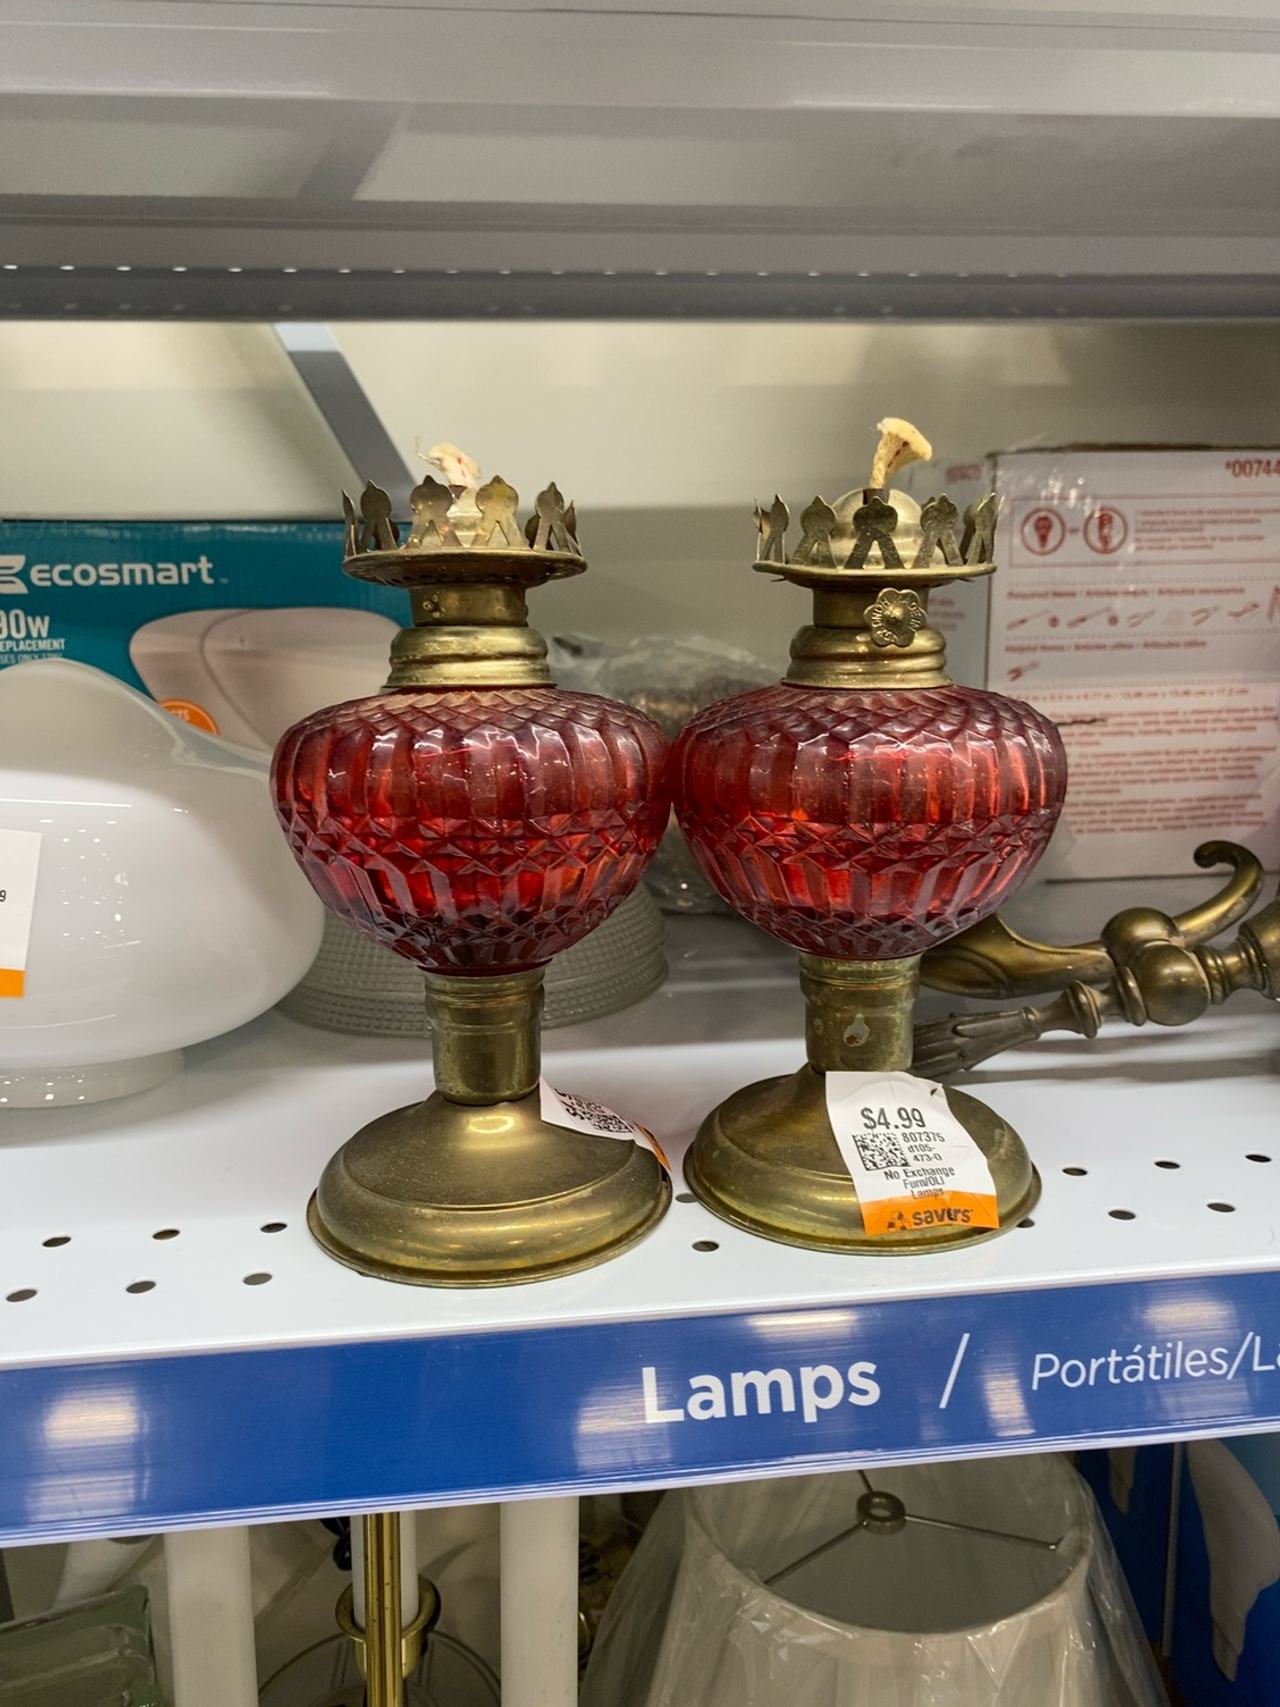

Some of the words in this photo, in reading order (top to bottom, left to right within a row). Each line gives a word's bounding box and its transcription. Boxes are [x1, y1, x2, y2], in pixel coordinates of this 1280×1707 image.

[30, 554, 214, 587] ecosmart
[0, 638, 65, 652] EPLACEMENT
[861, 1106, 926, 1130] $4.99
[901, 1131, 945, 1143] 807375
[884, 1170, 900, 1181] No
[902, 1166, 955, 1178] Exchange
[911, 1187, 945, 1200] Lamps
[641, 1360, 881, 1424] Lamps
[1032, 1331, 1280, 1391] Portátiles/L
